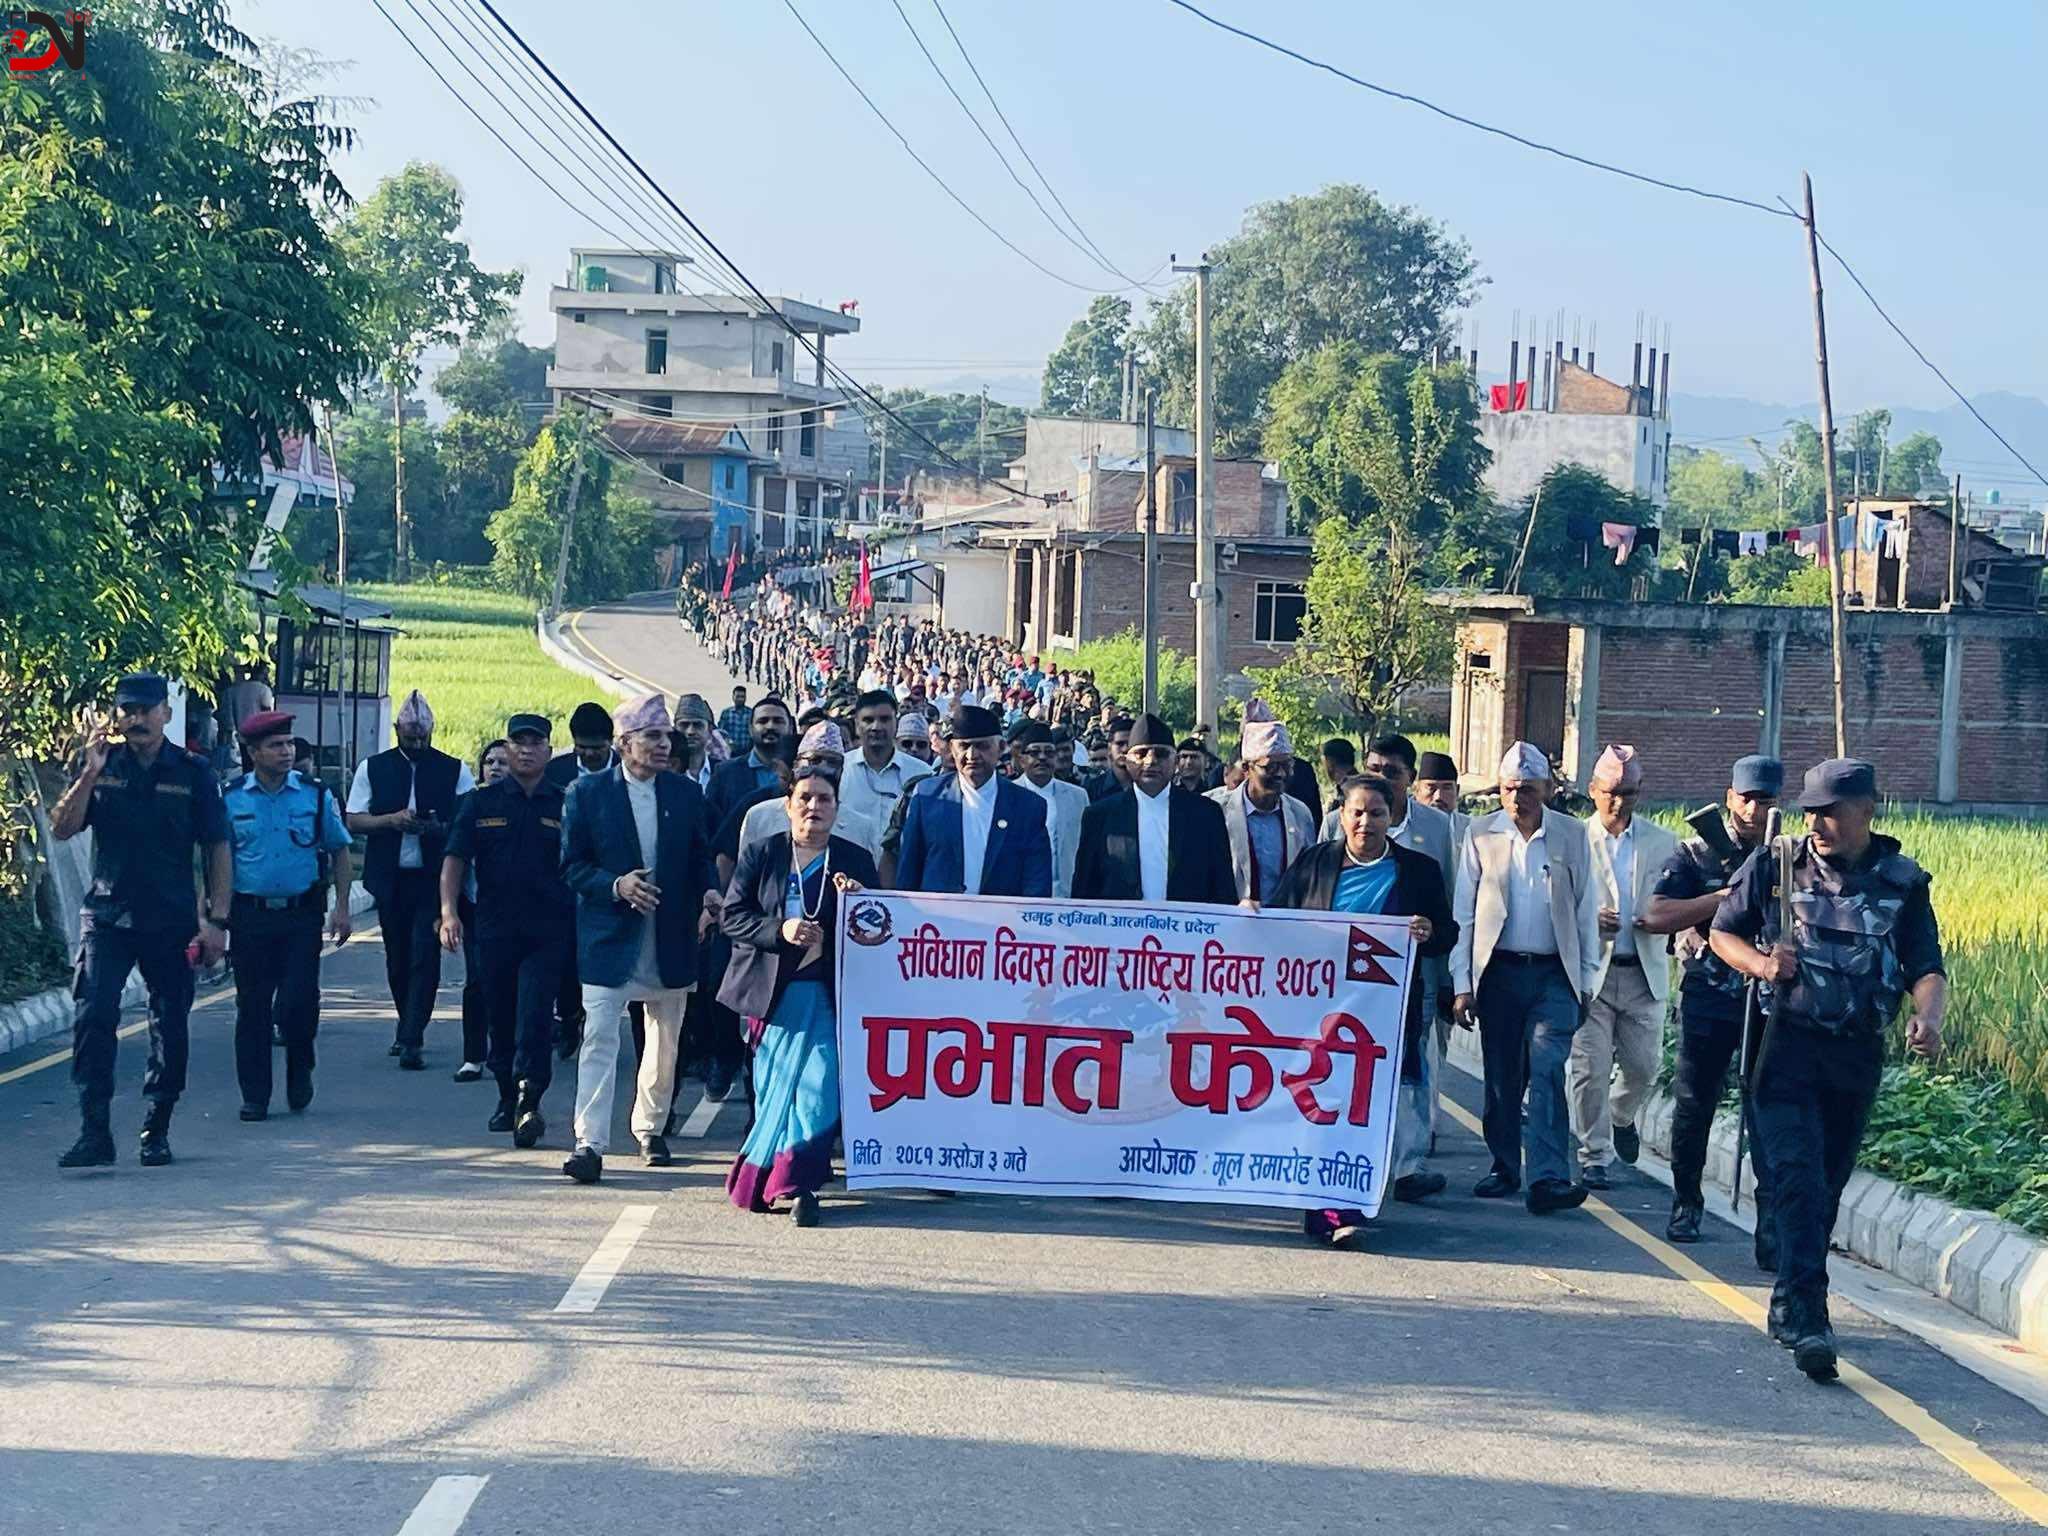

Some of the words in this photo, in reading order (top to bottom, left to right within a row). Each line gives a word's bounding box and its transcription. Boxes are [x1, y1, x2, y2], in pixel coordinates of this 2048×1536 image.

[1184, 918, 1219, 934] प्रदेश
[898, 922, 987, 981] संविधान
[994, 926, 1056, 987] दिवस
[1063, 945, 1110, 988] तथा
[1116, 934, 1196, 1004] राष्ट्रिय
[1275, 957, 1336, 999] २०८१
[861, 1016, 1134, 1114] प्रभात
[1166, 1005, 1387, 1127] फेरी
[896, 1145, 933, 1166] २०८१
[938, 1142, 984, 1169] असोज
[988, 1151, 997, 1172] ३
[1003, 1146, 1027, 1172] गते
[1118, 1137, 1198, 1176] आयोजक
[1212, 1151, 1245, 1186] मूल
[1249, 1147, 1313, 1185] समारोह
[1317, 1150, 1374, 1192] समिति
